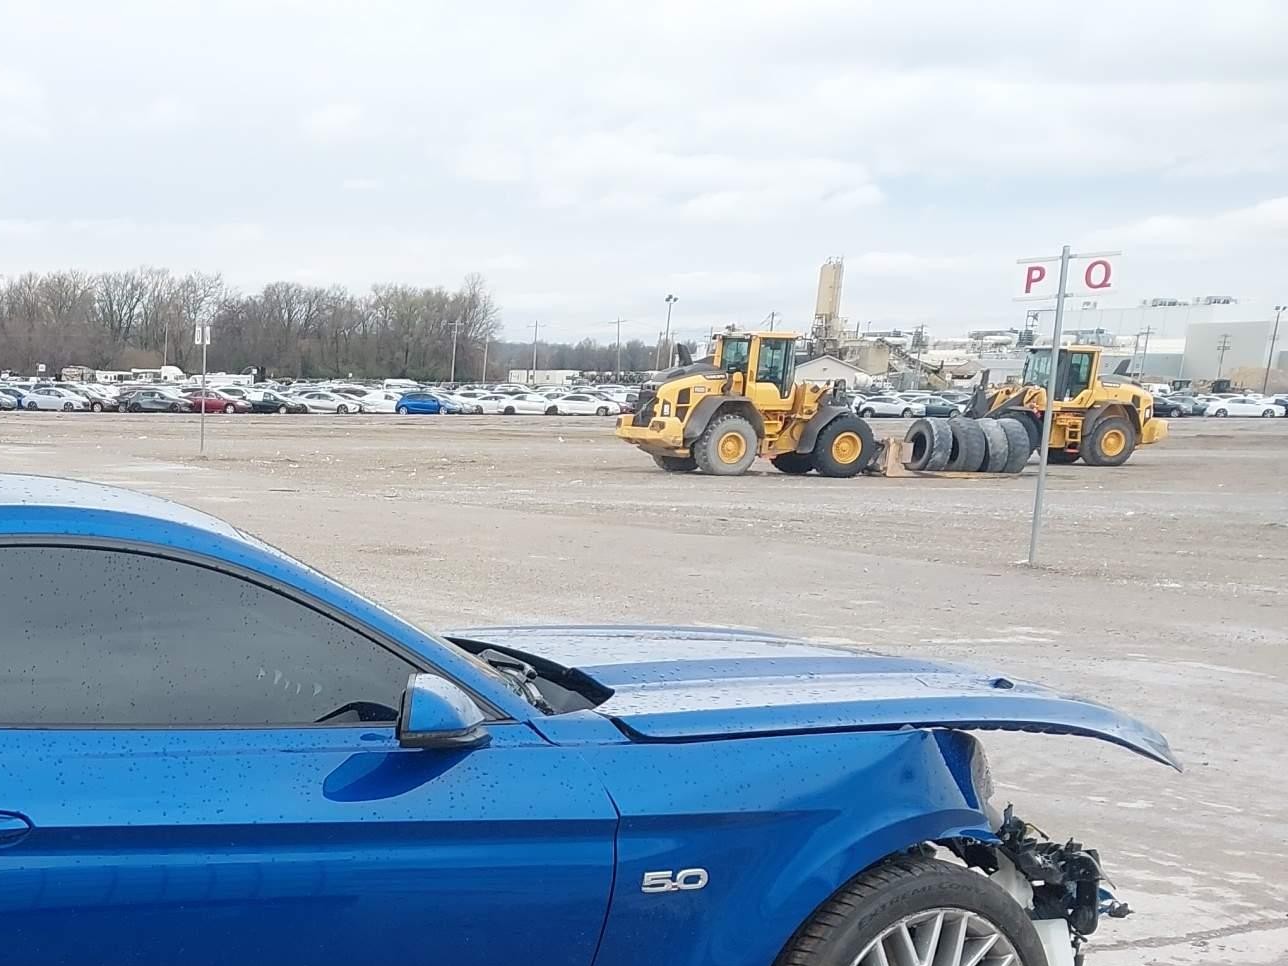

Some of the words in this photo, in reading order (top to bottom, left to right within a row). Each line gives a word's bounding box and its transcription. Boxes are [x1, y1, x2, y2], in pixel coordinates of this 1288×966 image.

[1025, 266, 1046, 294] P
[1085, 260, 1112, 289] Q
[641, 868, 709, 893] 5.0
